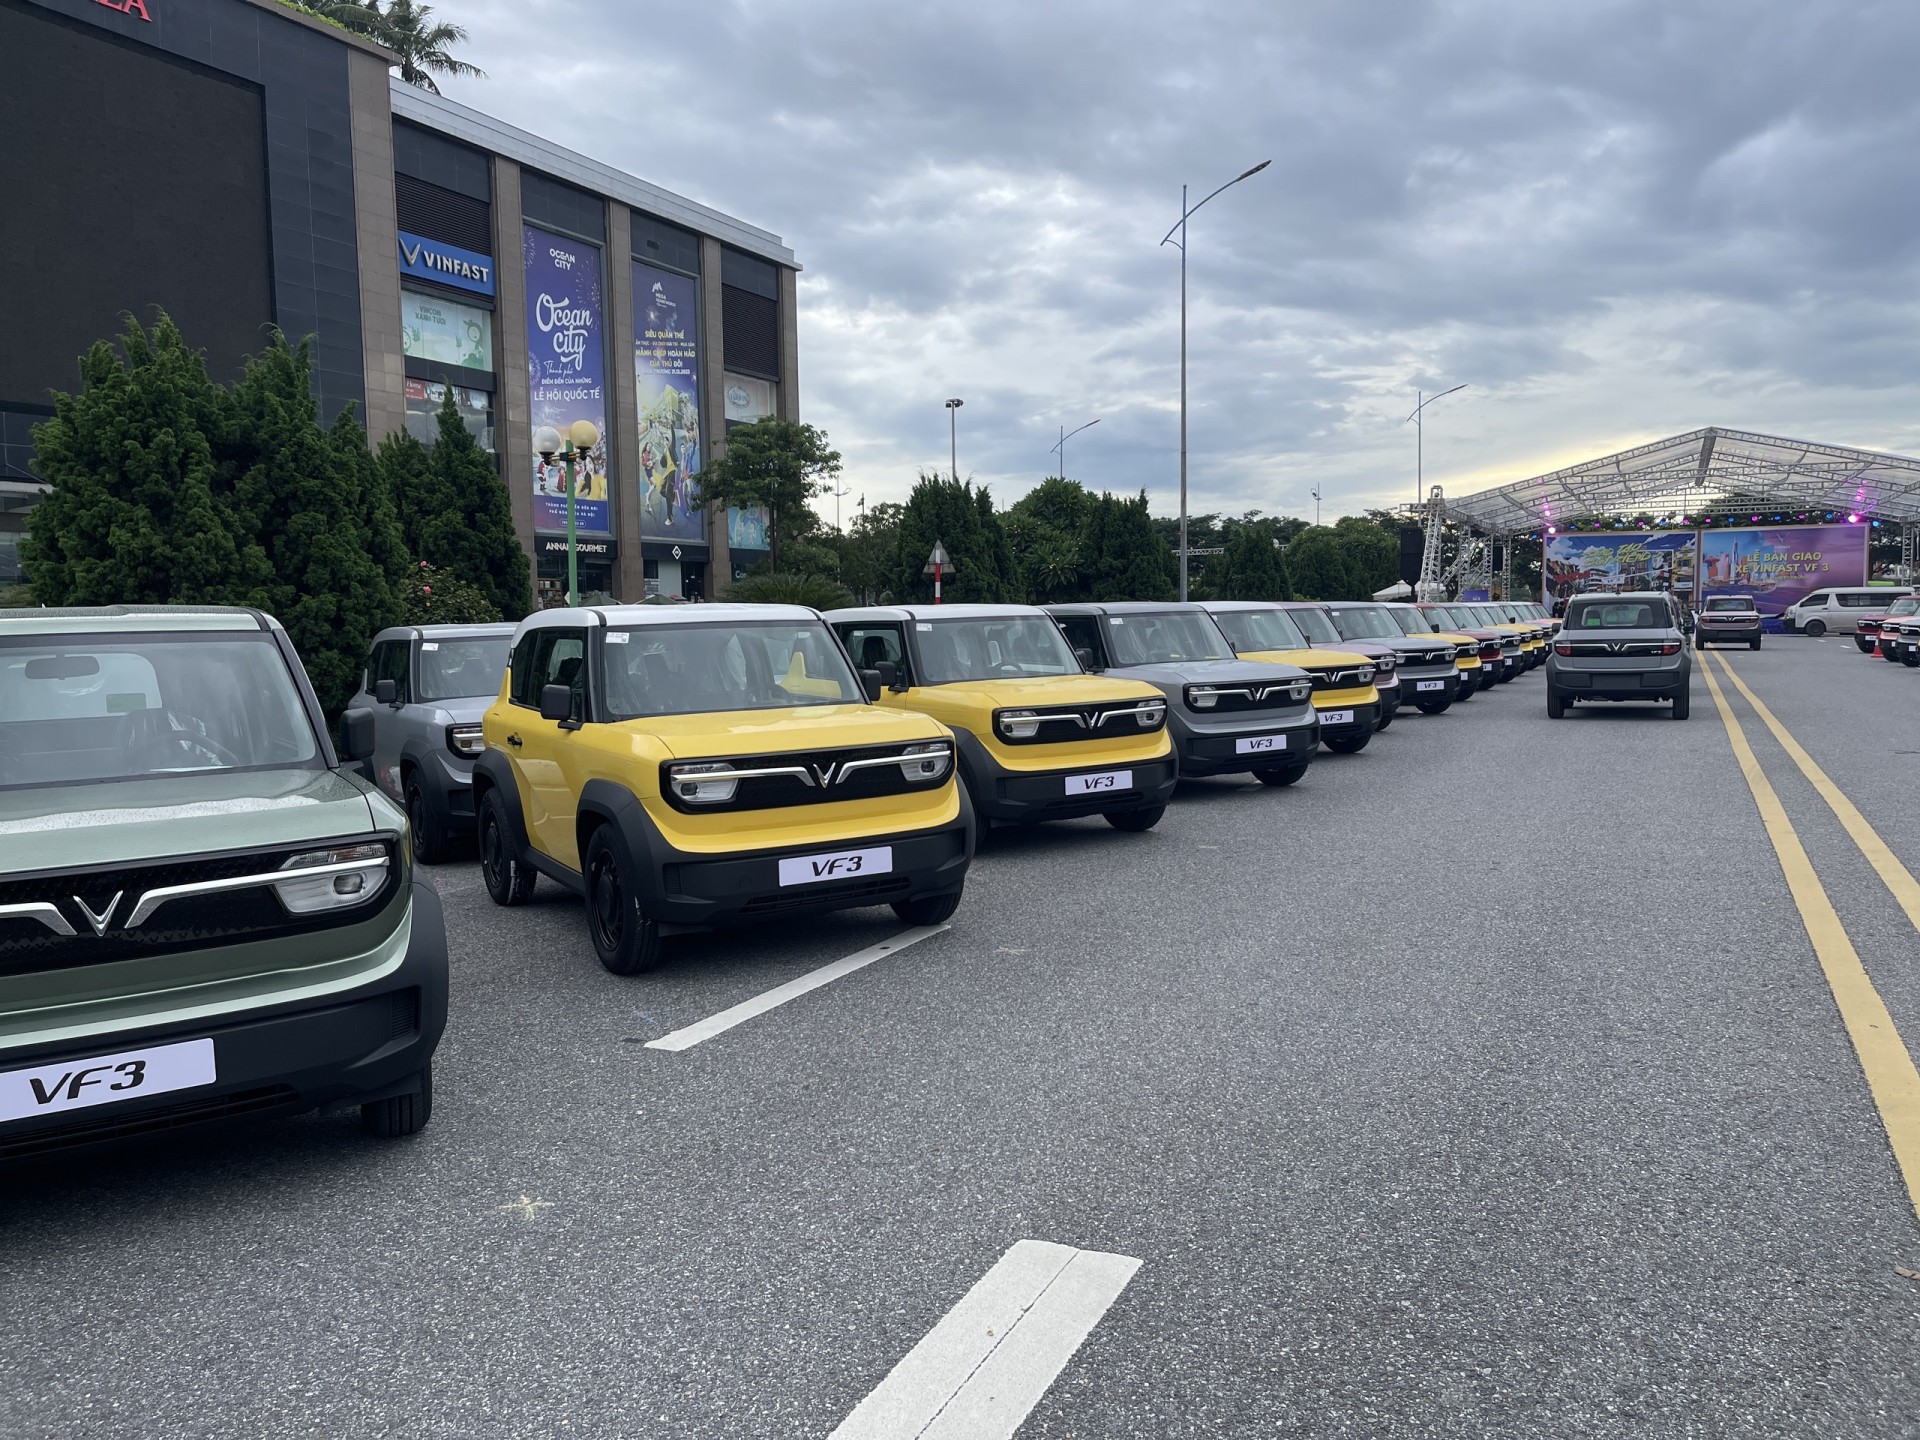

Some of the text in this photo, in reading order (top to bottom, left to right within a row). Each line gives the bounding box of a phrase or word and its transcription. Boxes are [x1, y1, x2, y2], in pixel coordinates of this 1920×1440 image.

[549, 248, 576, 264] OCEAN
[423, 250, 489, 283] VINFAST
[554, 259, 572, 271] CITY
[535, 292, 593, 332] Ocean
[534, 386, 601, 402] LỄ HỘI QUỐC TẾ
[575, 543, 608, 553] GOURMET
[1791, 551, 1822, 561] GIAO
[1735, 562, 1830, 573] XE VINFAST VF 3
[1324, 713, 1343, 722] VF3
[1249, 738, 1273, 750] VF3
[1084, 775, 1115, 790] VF3
[811, 855, 863, 877] VF3
[28, 1059, 147, 1105] VF3
